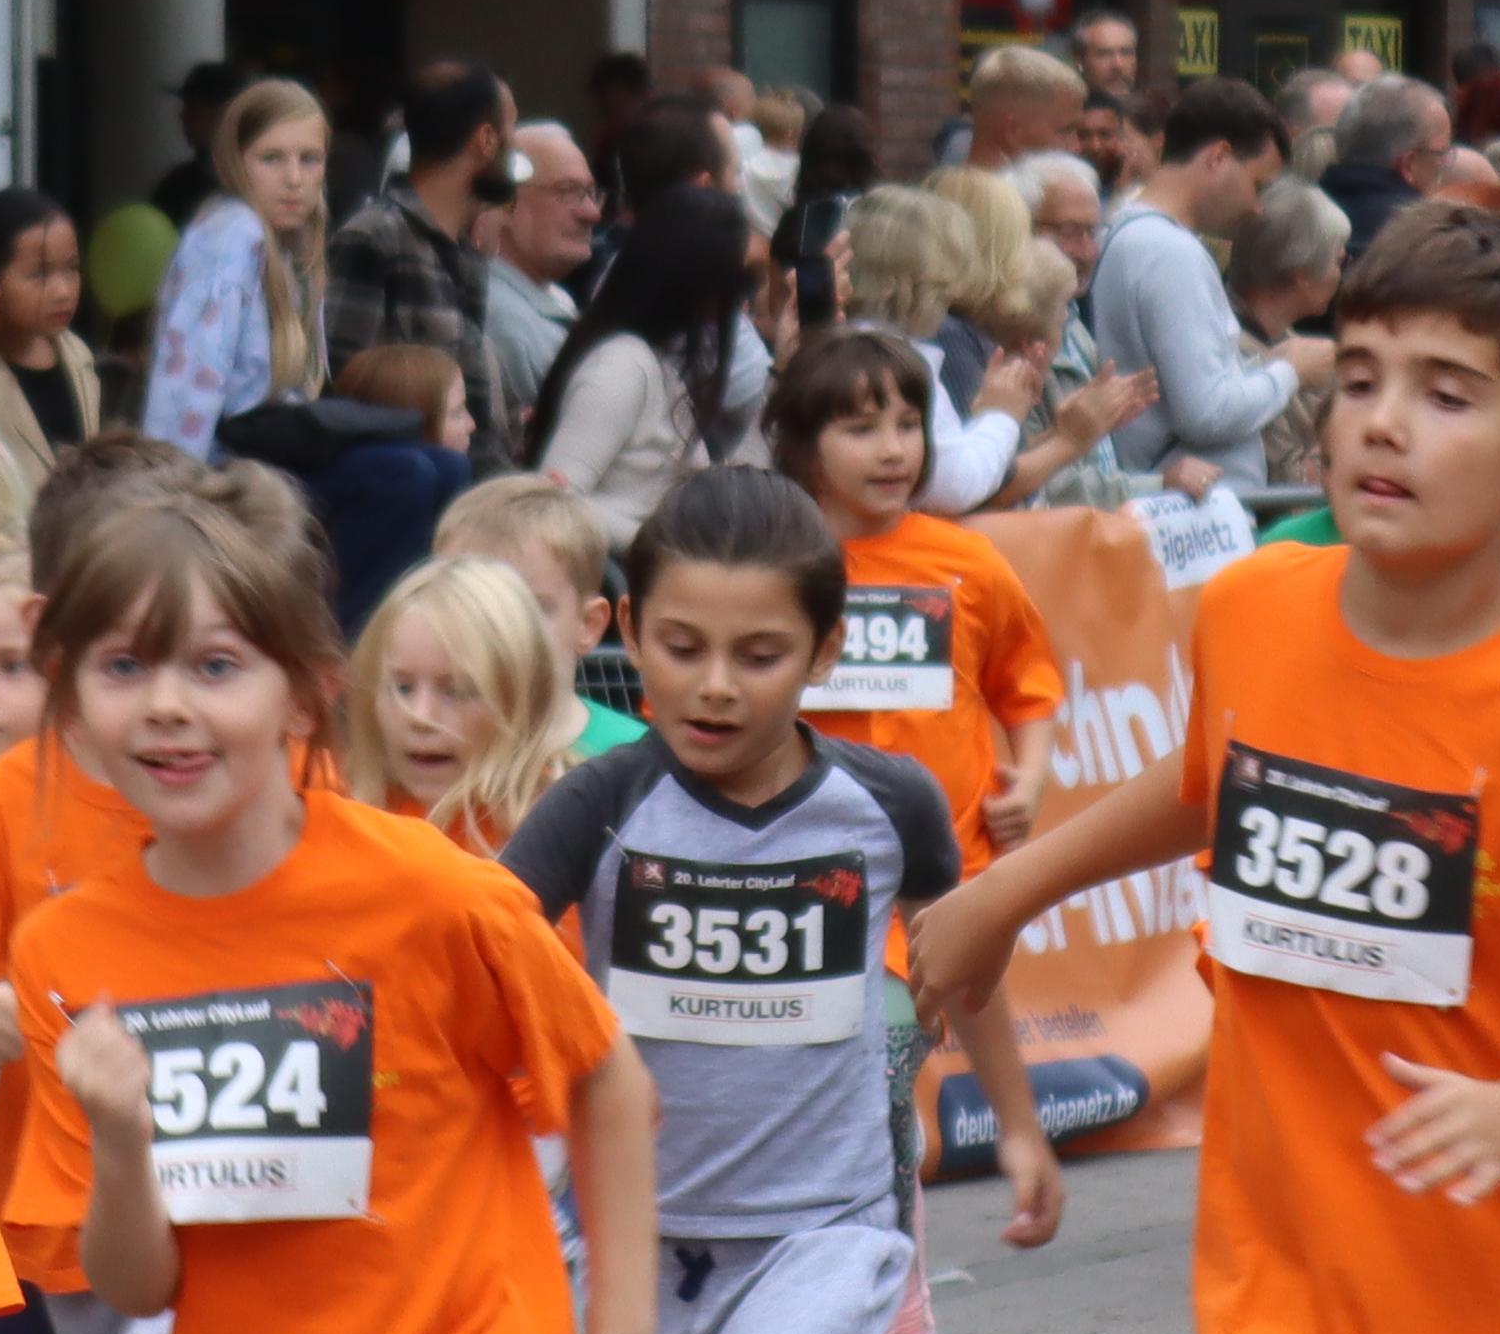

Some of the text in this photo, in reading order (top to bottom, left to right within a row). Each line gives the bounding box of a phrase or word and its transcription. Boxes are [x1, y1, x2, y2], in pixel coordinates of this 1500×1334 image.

[842, 613, 930, 662] 494
[822, 675, 909, 693] KURTULUS
[697, 874, 744, 889] Lehrter
[1234, 804, 1432, 921] 3528
[648, 903, 825, 976] 3531
[1241, 917, 1388, 969] KURTULUS
[669, 994, 804, 1019] KURTULUS
[151, 1039, 329, 1136] 524
[157, 1158, 287, 1189] RTULUS
